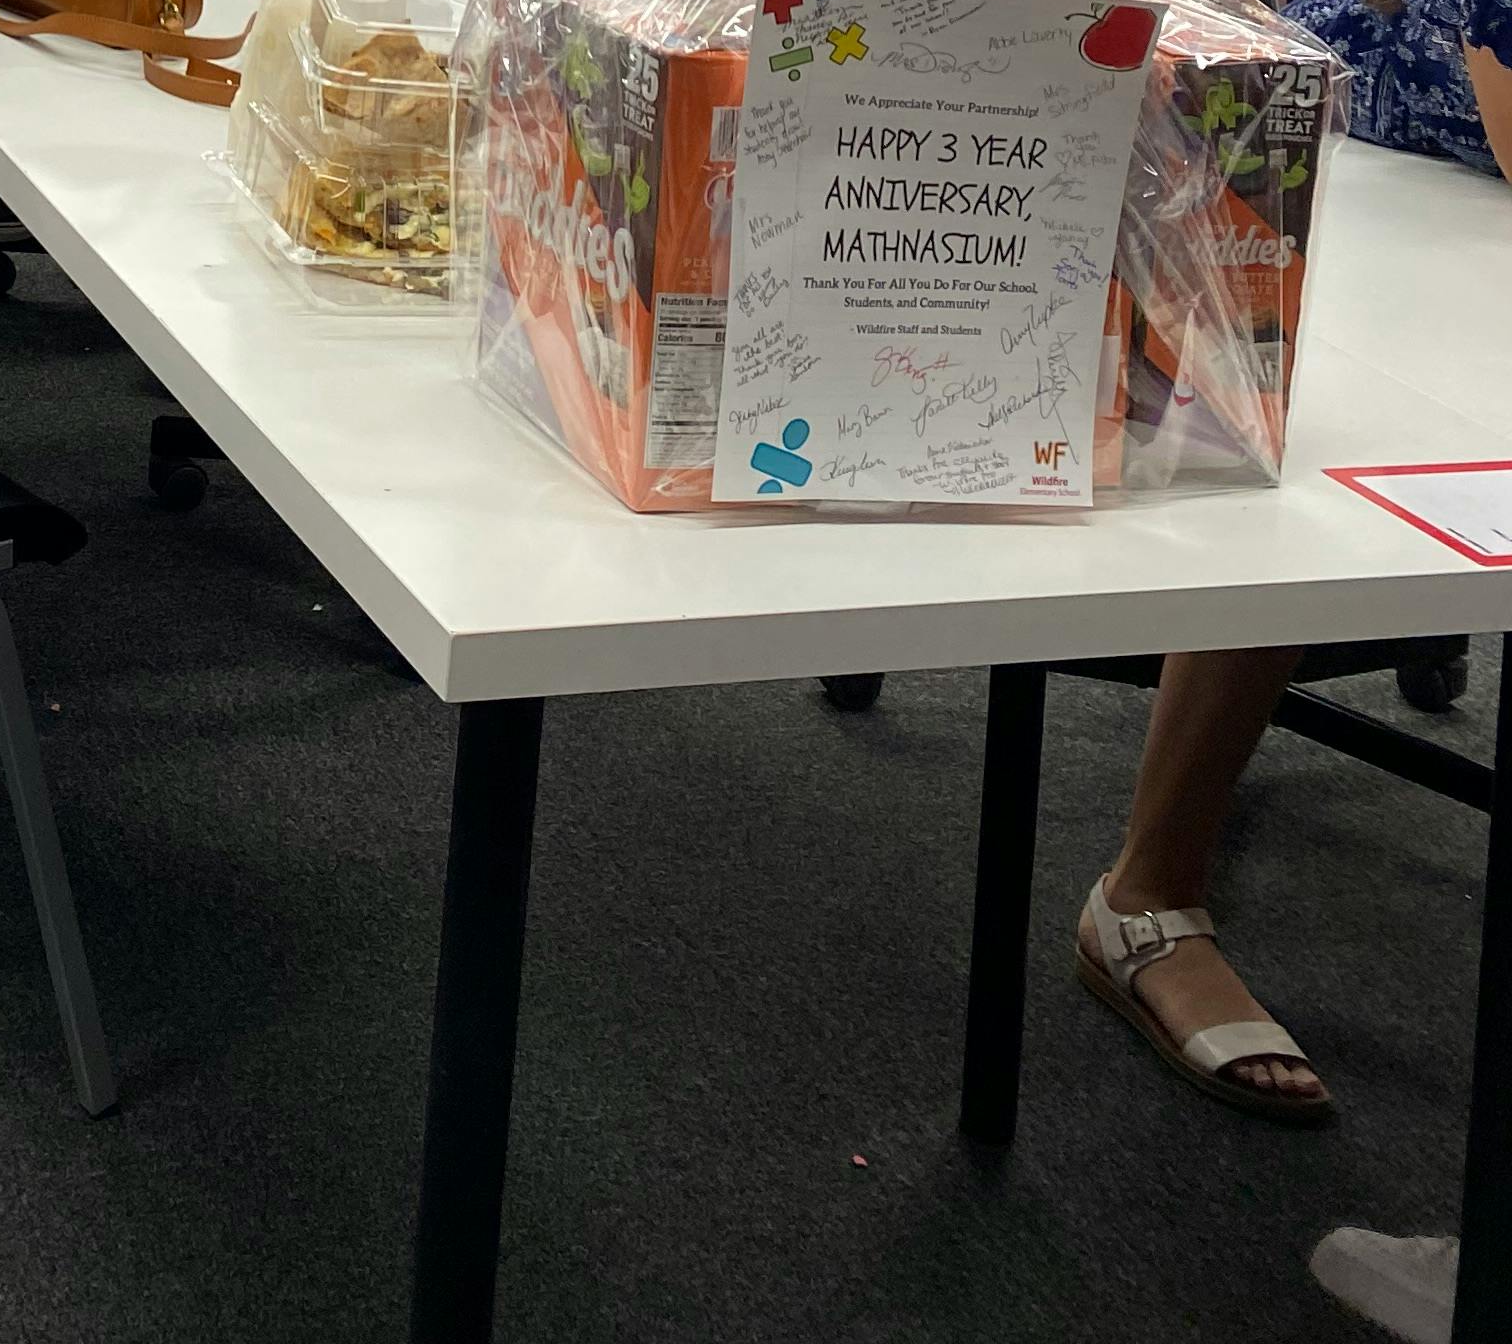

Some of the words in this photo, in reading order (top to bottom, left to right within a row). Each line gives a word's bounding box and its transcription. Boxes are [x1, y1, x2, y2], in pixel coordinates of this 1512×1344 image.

[1269, 64, 1322, 108] 25
[844, 94, 865, 106] We
[868, 95, 933, 110] Appreciate
[936, 100, 966, 113] Your
[968, 102, 1040, 118] Partnership!
[1267, 108, 1302, 119] TRICK
[624, 104, 655, 132] TREAT
[1266, 119, 1314, 135] TREAT
[838, 126, 932, 162] HAPPY
[937, 133, 958, 162] 3
[971, 134, 1048, 170] YEAR
[825, 175, 1036, 222] ANNIVERSARY,
[750, 210, 805, 250] Newman
[824, 228, 1026, 268] MATHNASIUM!
[803, 276, 840, 290] Thank
[842, 278, 865, 290] You
[868, 278, 887, 290] For
[889, 278, 906, 290] All
[909, 278, 931, 290] You
[934, 279, 950, 290] Do
[952, 280, 971, 292] For
[974, 280, 996, 292] Our
[998, 281, 1038, 294] School,
[661, 298, 704, 306] Nutrition
[844, 296, 894, 310] Students,
[896, 298, 918, 308] and
[919, 298, 990, 312] Community!
[658, 334, 694, 342] Calories
[856, 324, 896, 334] Wildfire
[897, 324, 920, 335] Staff
[921, 325, 938, 335] and
[940, 326, 982, 336] Students
[1033, 440, 1070, 472] WF
[1032, 475, 1069, 486] Wildfire
[1020, 488, 1056, 498] Elementary
[1058, 488, 1080, 497] School
